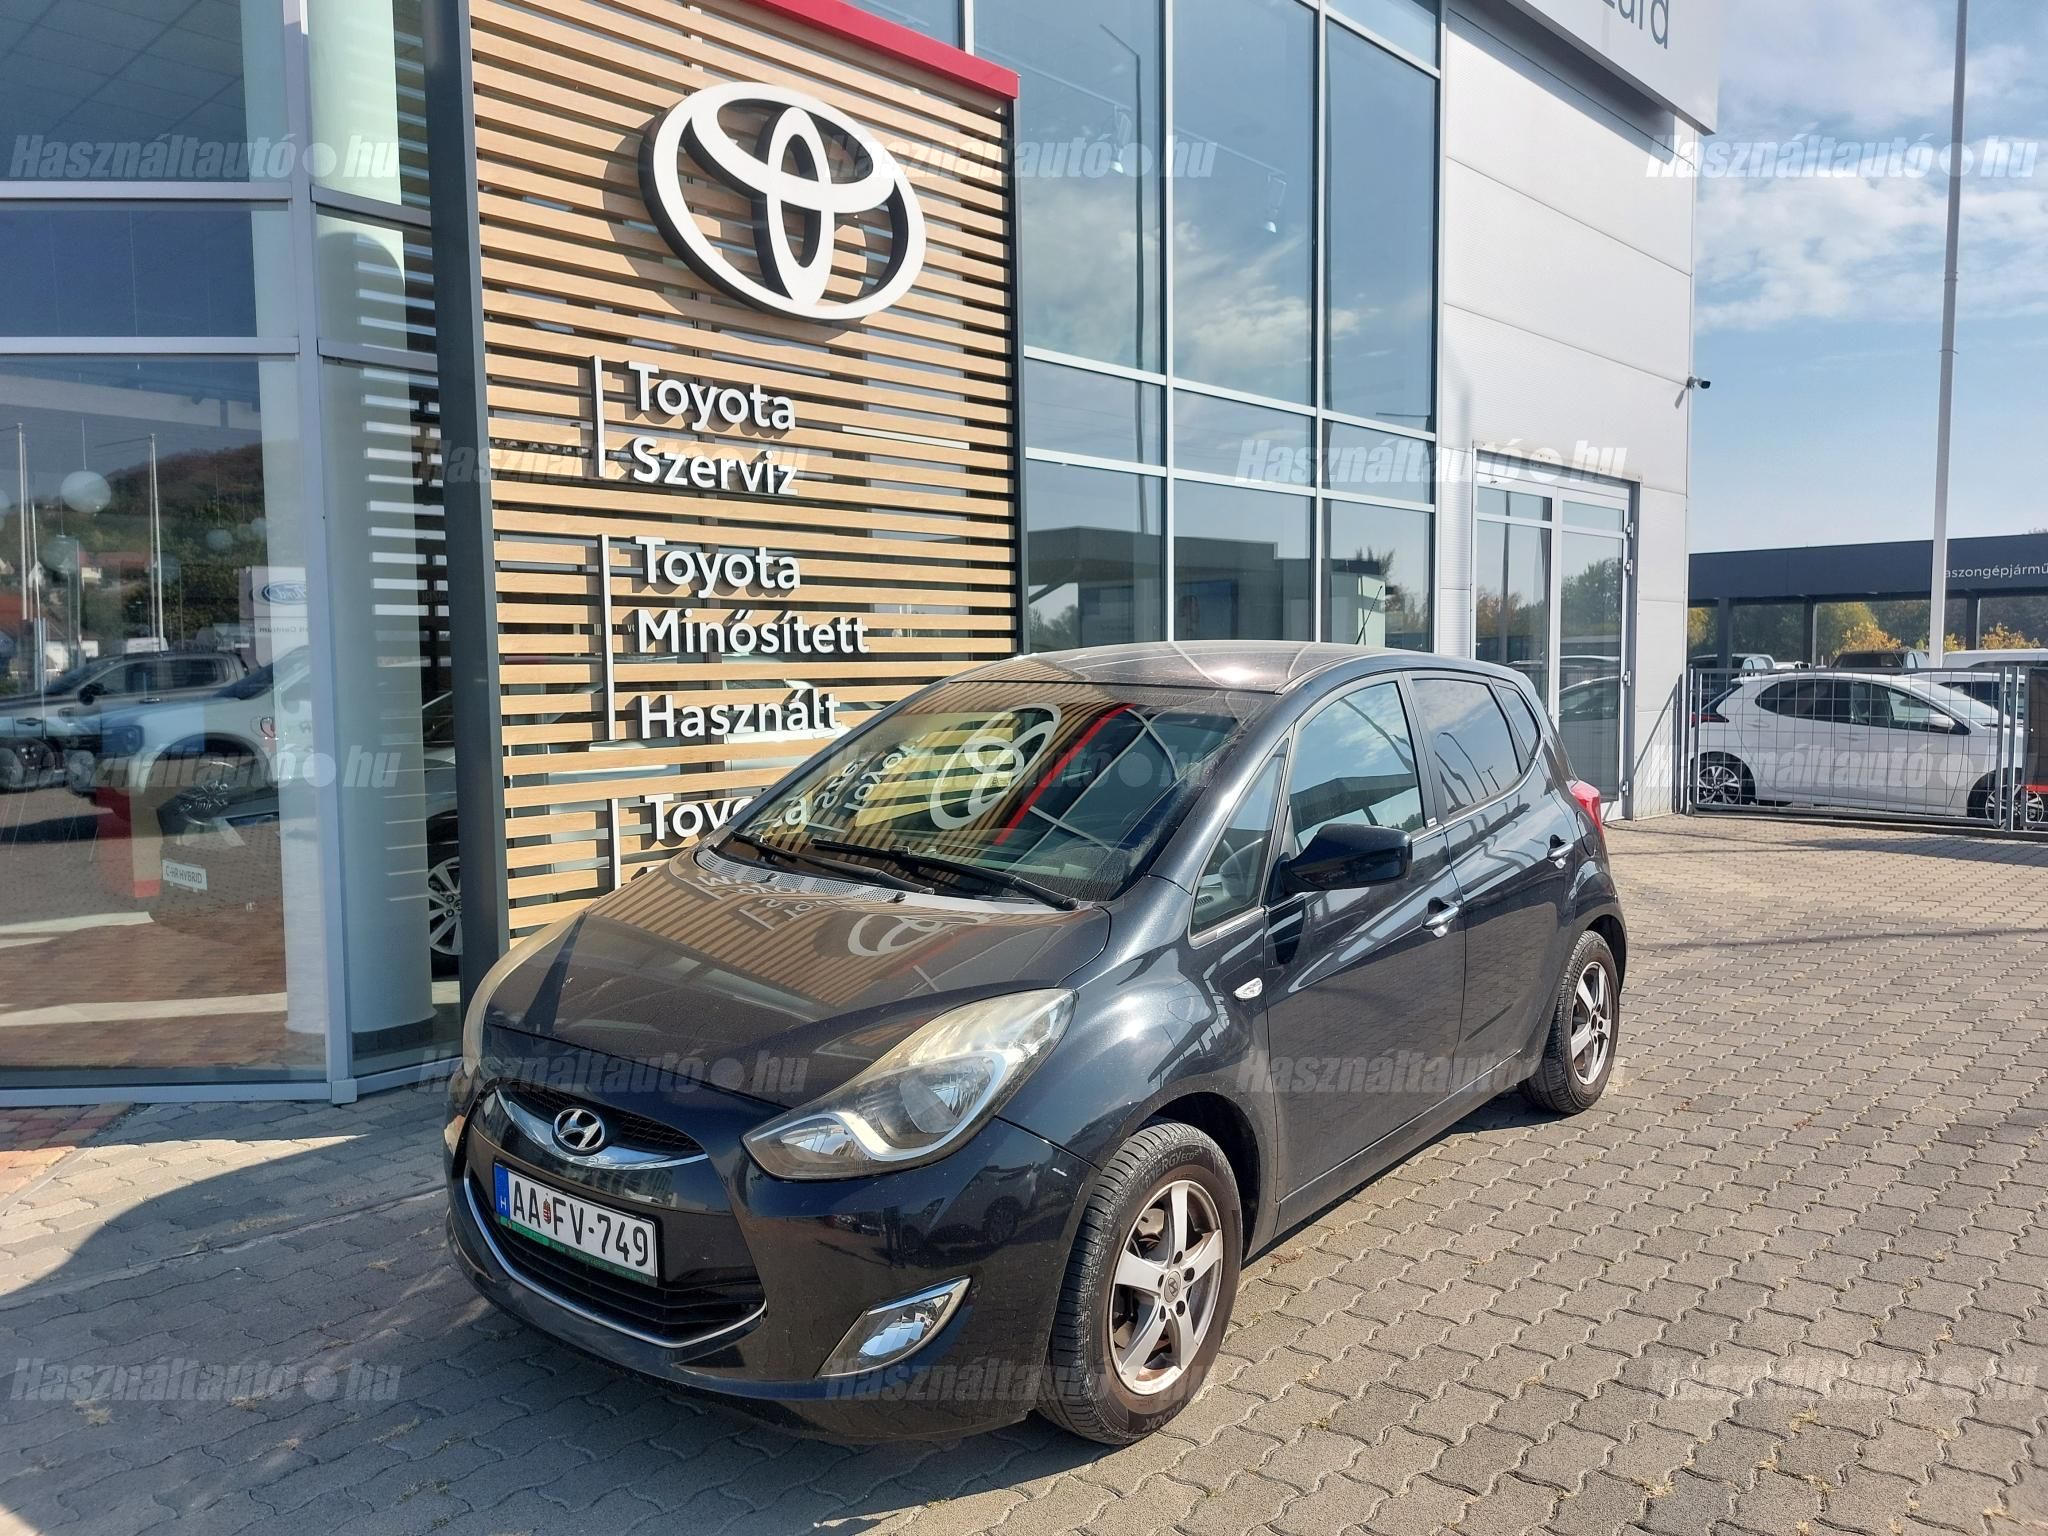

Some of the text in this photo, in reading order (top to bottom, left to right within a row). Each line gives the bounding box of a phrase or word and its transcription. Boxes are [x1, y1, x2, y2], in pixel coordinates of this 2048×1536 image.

[630, 361, 796, 432] Toyota
[633, 436, 800, 496] Szerviz
[634, 535, 801, 599] Toyota
[637, 607, 871, 655] Minősített
[640, 688, 842, 739] Használt
[500, 1196, 507, 1208] H
